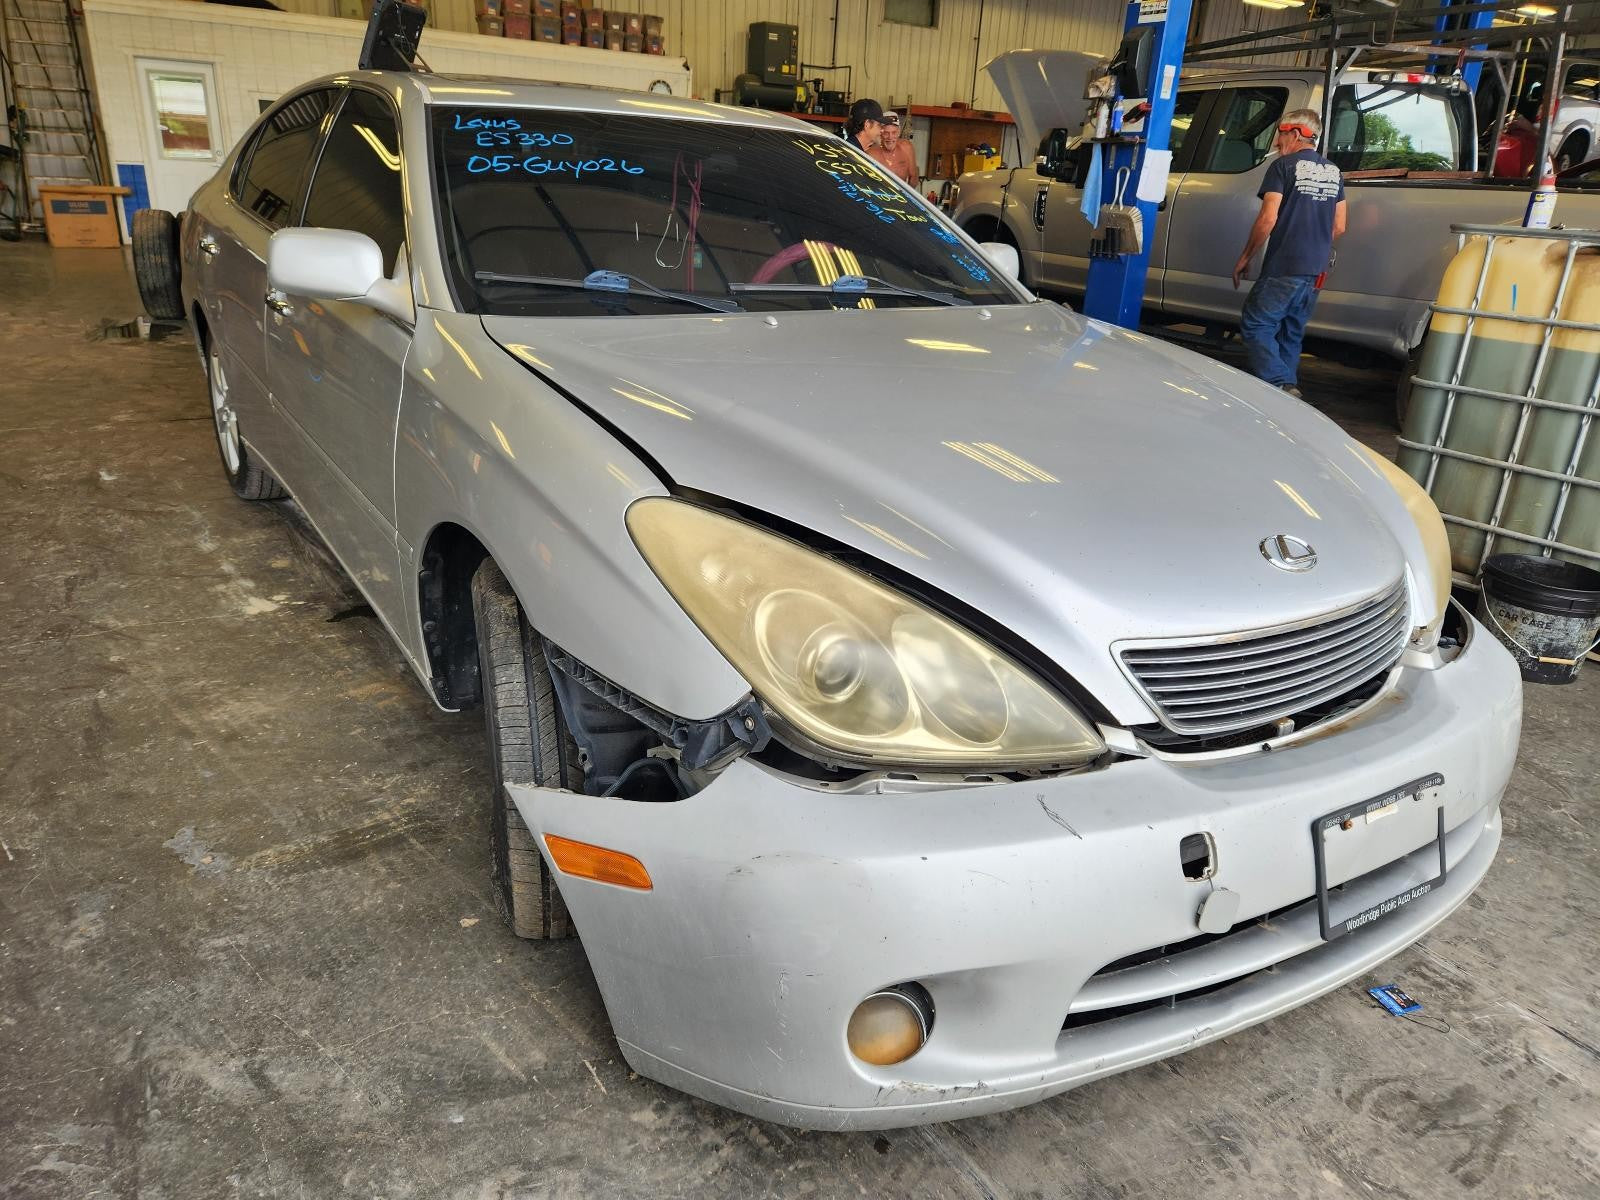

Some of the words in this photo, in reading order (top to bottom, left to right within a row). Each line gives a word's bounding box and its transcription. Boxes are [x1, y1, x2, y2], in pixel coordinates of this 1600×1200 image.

[1499, 608, 1519, 622] CAR
[1522, 617, 1553, 630] CARE
[1346, 908, 1380, 931] Woodbridge
[1380, 899, 1397, 914] Public
[1411, 884, 1431, 899] Auction
